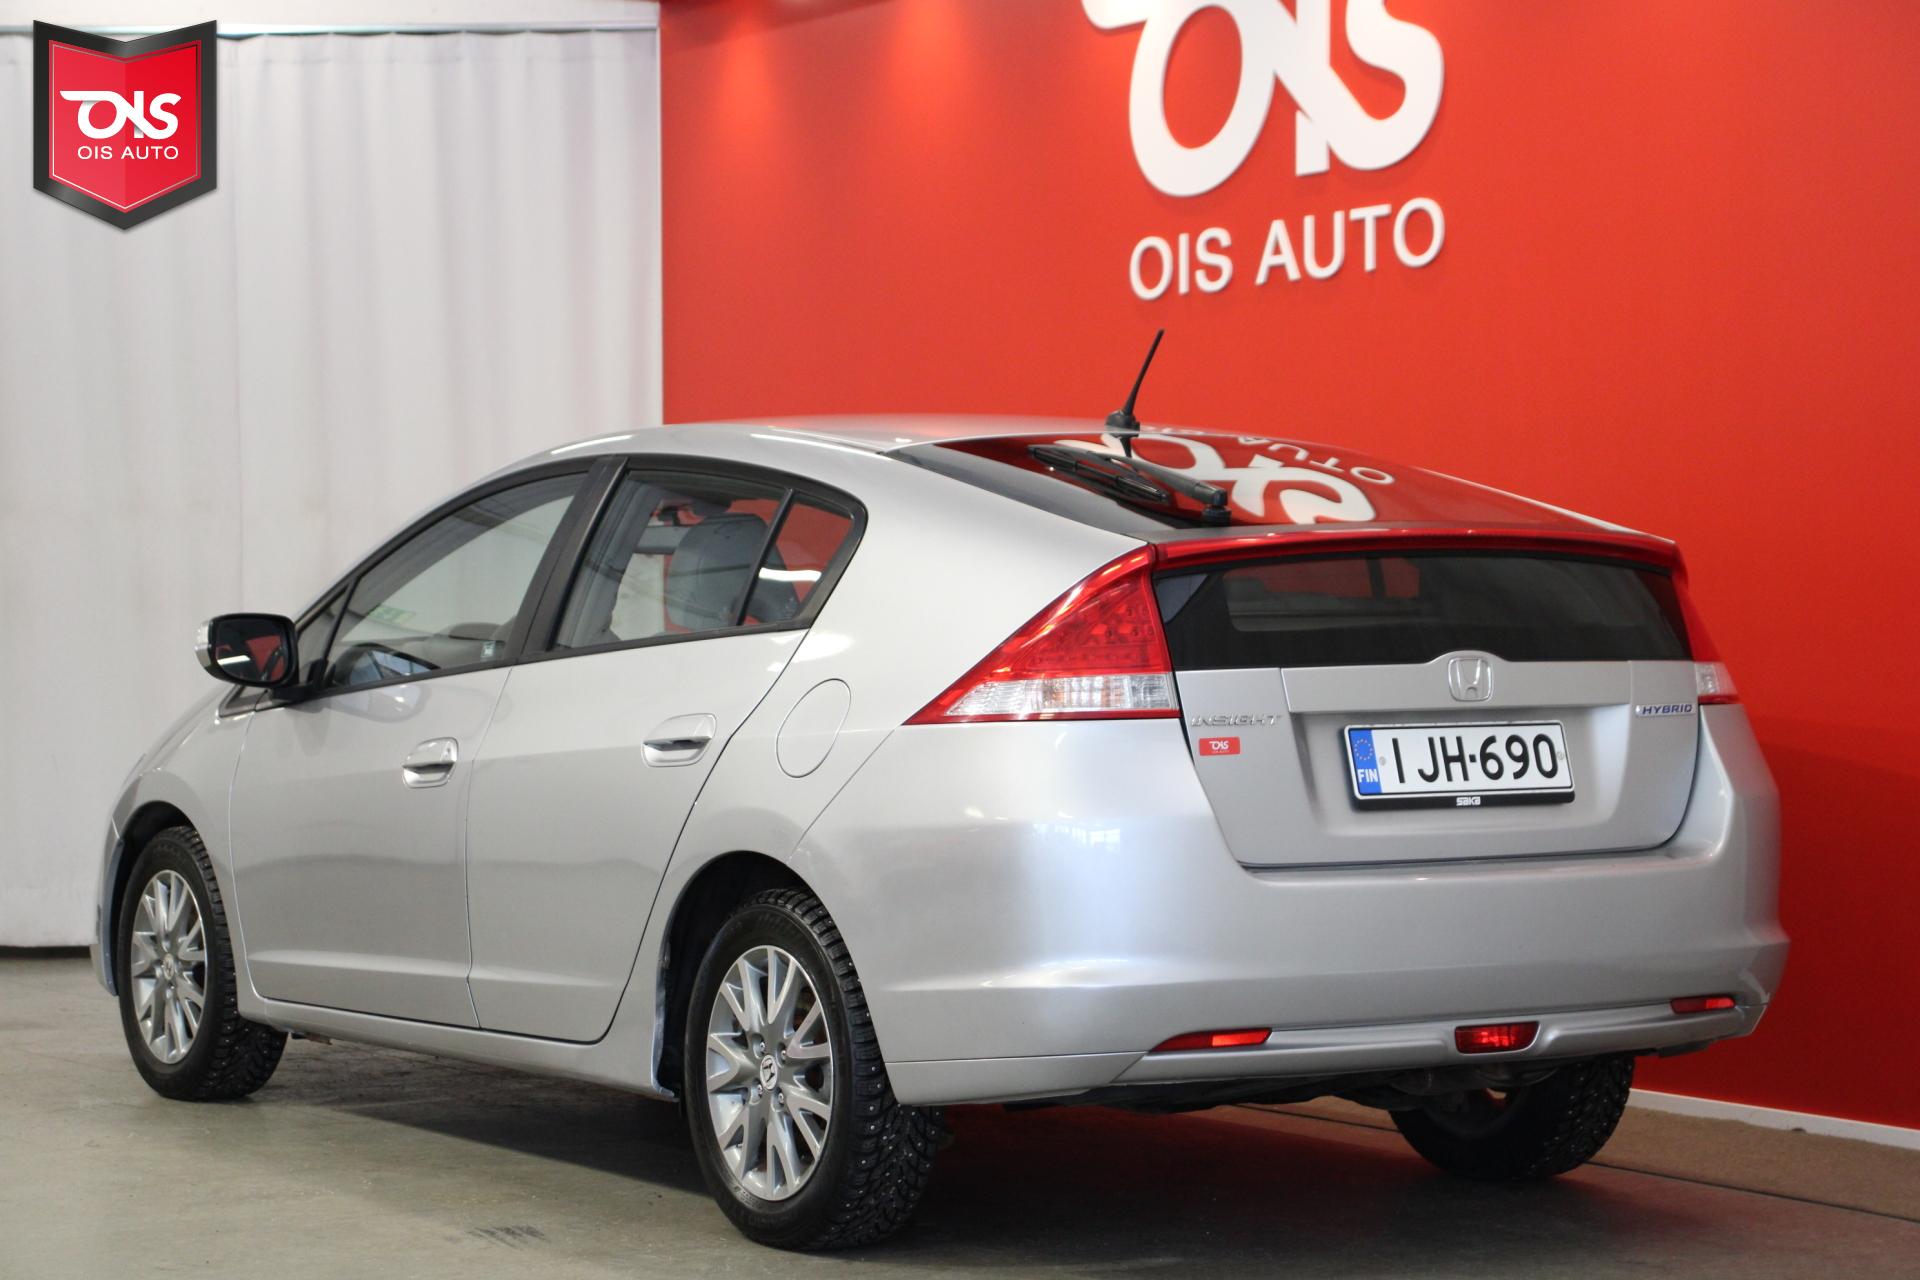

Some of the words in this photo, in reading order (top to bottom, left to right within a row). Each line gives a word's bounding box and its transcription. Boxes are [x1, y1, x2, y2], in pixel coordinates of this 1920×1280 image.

[1129, 227, 1234, 300] OIS
[1255, 197, 1445, 285] AUTO
[1642, 703, 1693, 715] HYBRID
[1191, 714, 1281, 728] INSIGHT
[1392, 733, 1559, 784] IJH-690
[1356, 768, 1379, 784] FIN
